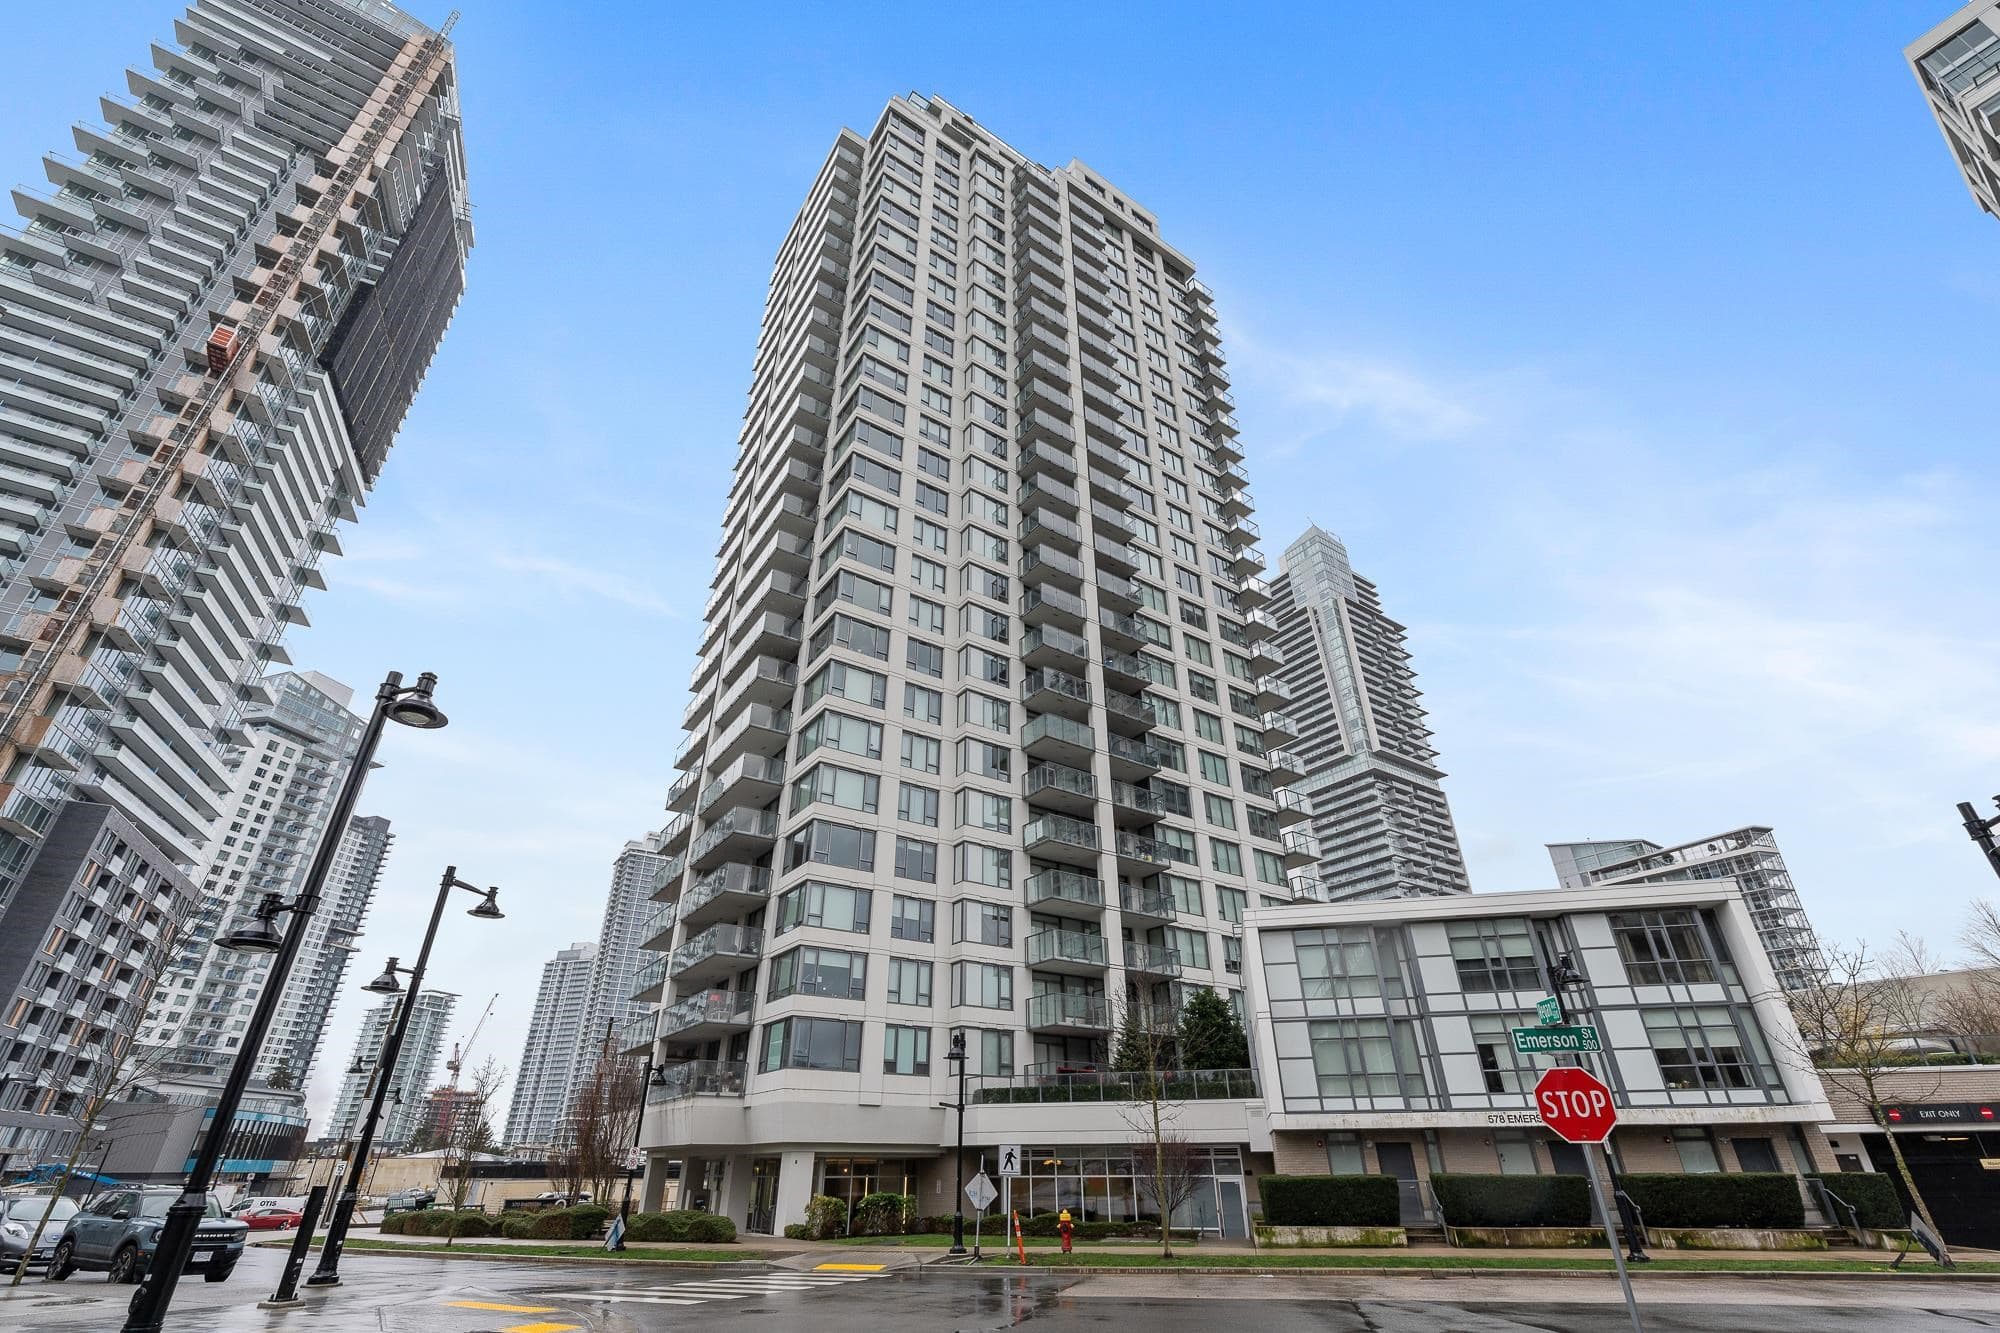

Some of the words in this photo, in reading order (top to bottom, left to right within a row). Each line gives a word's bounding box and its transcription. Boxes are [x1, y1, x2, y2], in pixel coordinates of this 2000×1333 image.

[1515, 1032, 1579, 1049] Emerson
[1581, 1028, 1593, 1039] St
[1583, 1040, 1598, 1050] 500
[1542, 1090, 1606, 1119] STOP
[1488, 1114, 1506, 1124] 578
[1507, 1114, 1542, 1124] EMERS
[1919, 1110, 1936, 1118] EXIT
[1938, 1110, 1961, 1118] ONLY
